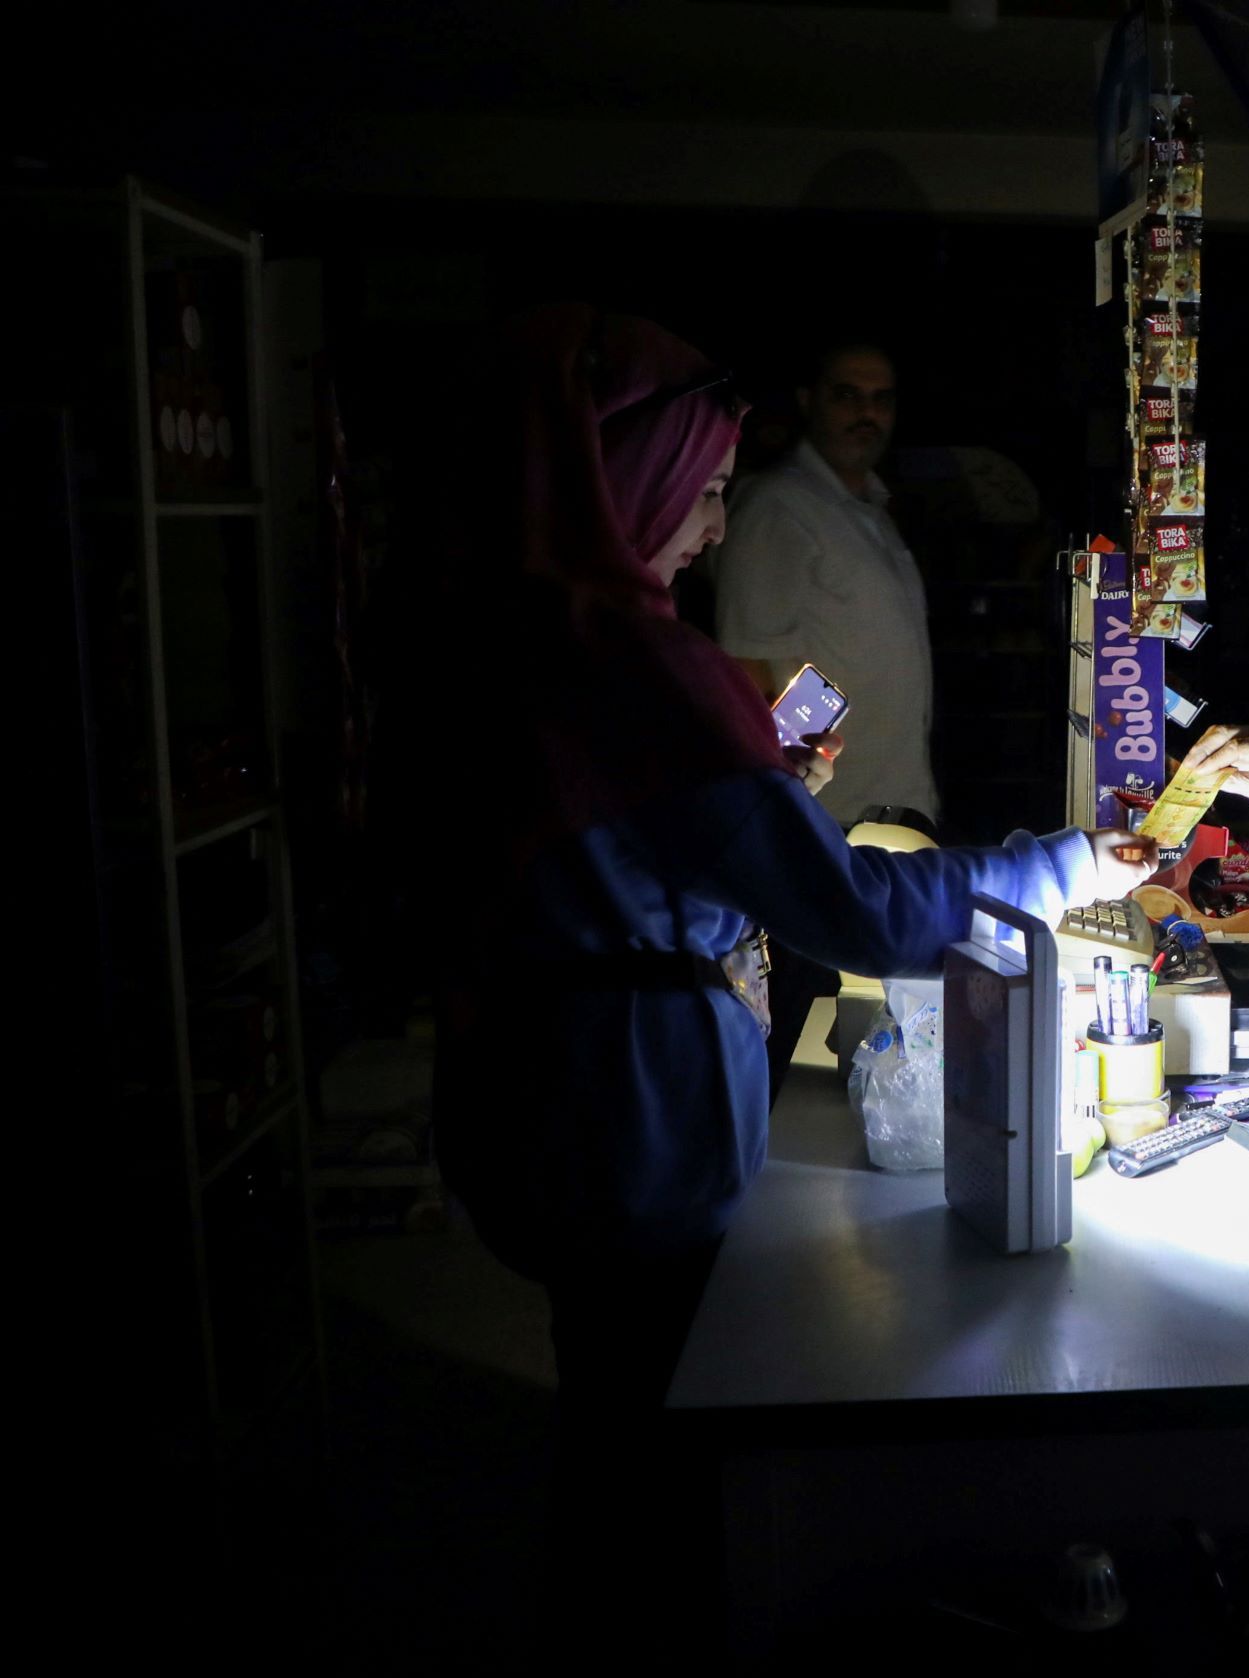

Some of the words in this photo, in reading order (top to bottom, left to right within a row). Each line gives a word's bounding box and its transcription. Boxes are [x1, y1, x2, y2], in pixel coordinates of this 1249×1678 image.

[1158, 527, 1186, 540] TORA
[1161, 539, 1187, 550] BIKA
[1155, 551, 1196, 563] Cappuccino
[1101, 590, 1130, 600] DAIRY
[1099, 615, 1157, 762] Bubbly
